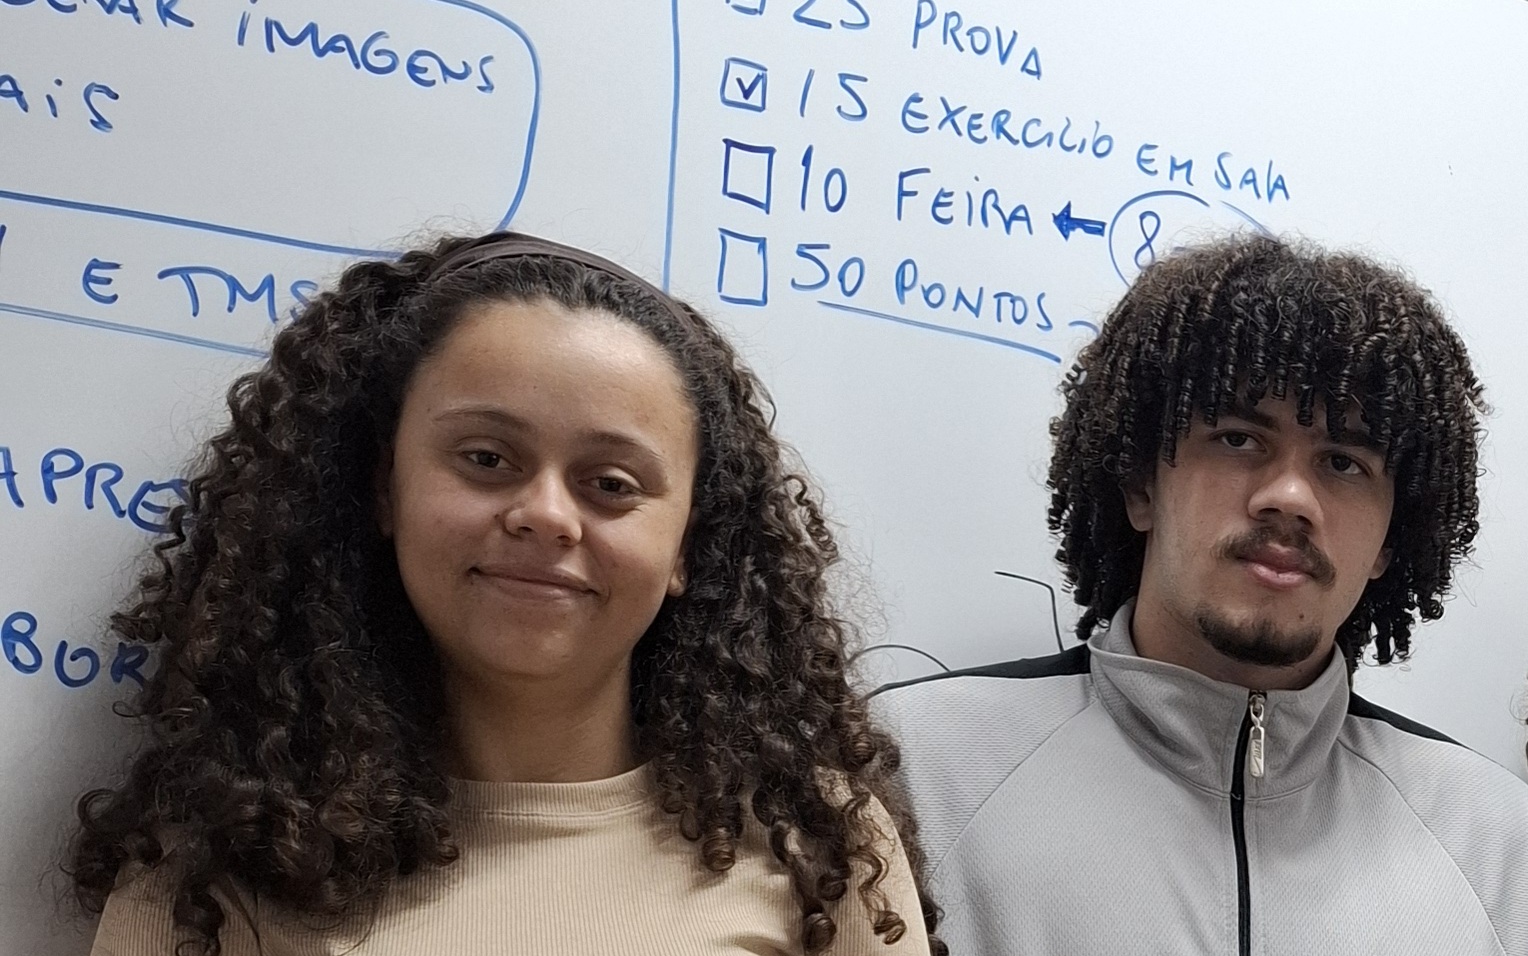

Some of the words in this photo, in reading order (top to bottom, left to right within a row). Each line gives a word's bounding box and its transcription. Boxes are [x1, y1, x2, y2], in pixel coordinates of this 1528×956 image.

[912, 0, 1043, 81] PROVA
[799, 68, 868, 121] 15
[1136, 143, 1194, 187] EM
[799, 144, 848, 214] 10
[791, 243, 865, 297] 50
[895, 258, 1054, 331] PONTOS
